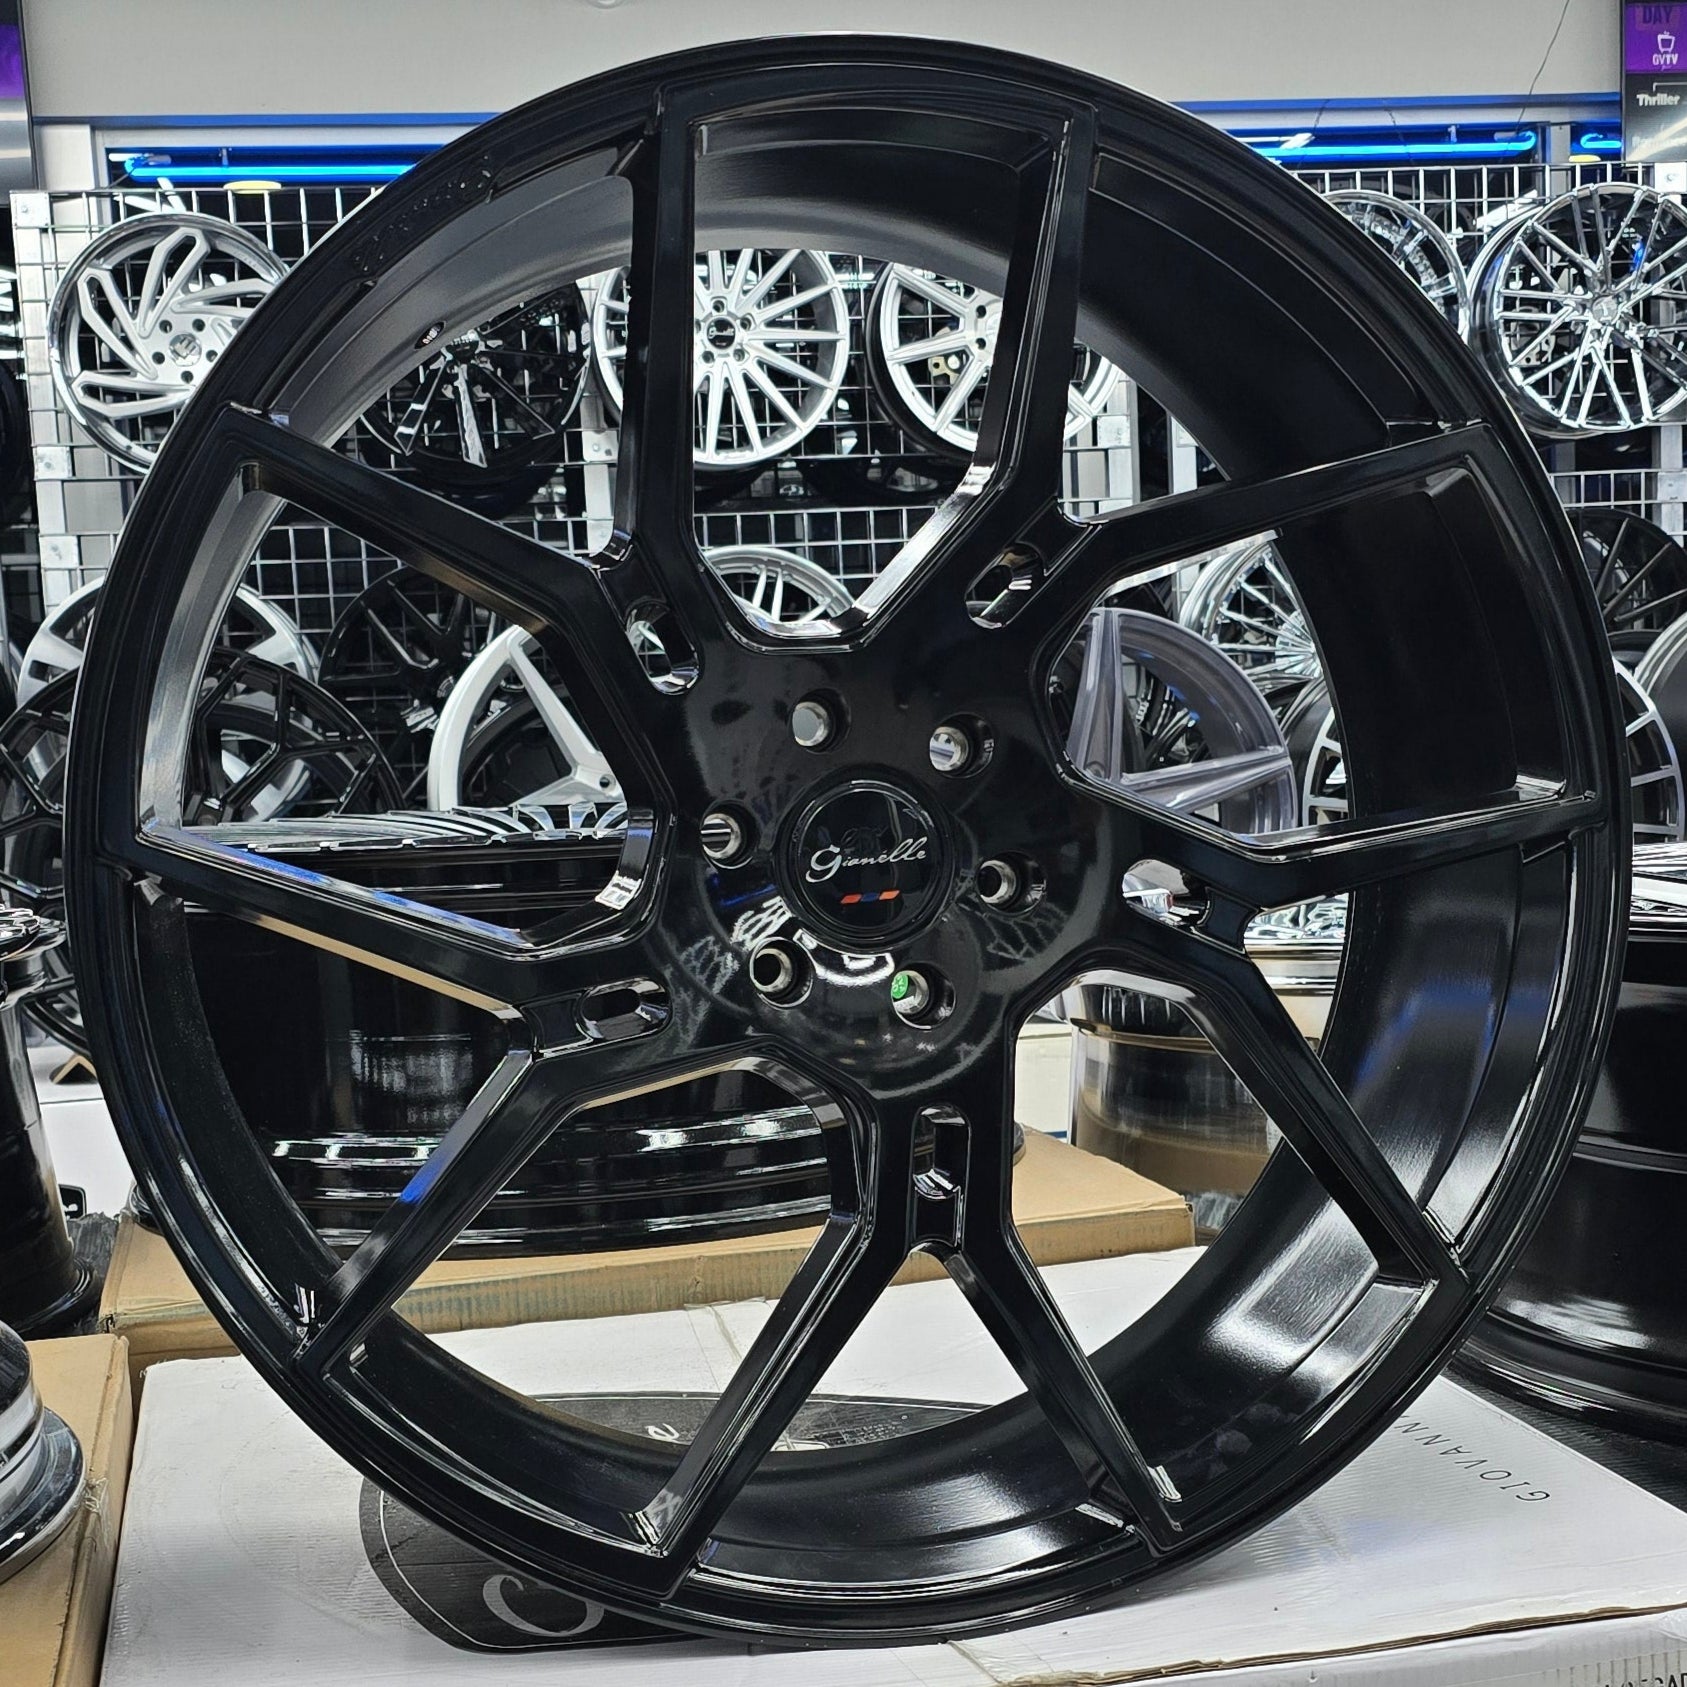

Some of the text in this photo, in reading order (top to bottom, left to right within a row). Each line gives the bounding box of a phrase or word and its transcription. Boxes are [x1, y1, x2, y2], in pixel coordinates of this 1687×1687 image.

[1643, 5, 1673, 25] DAY
[1636, 93, 1680, 106] Thriller
[1394, 1415, 1551, 1502] GIOVANN
